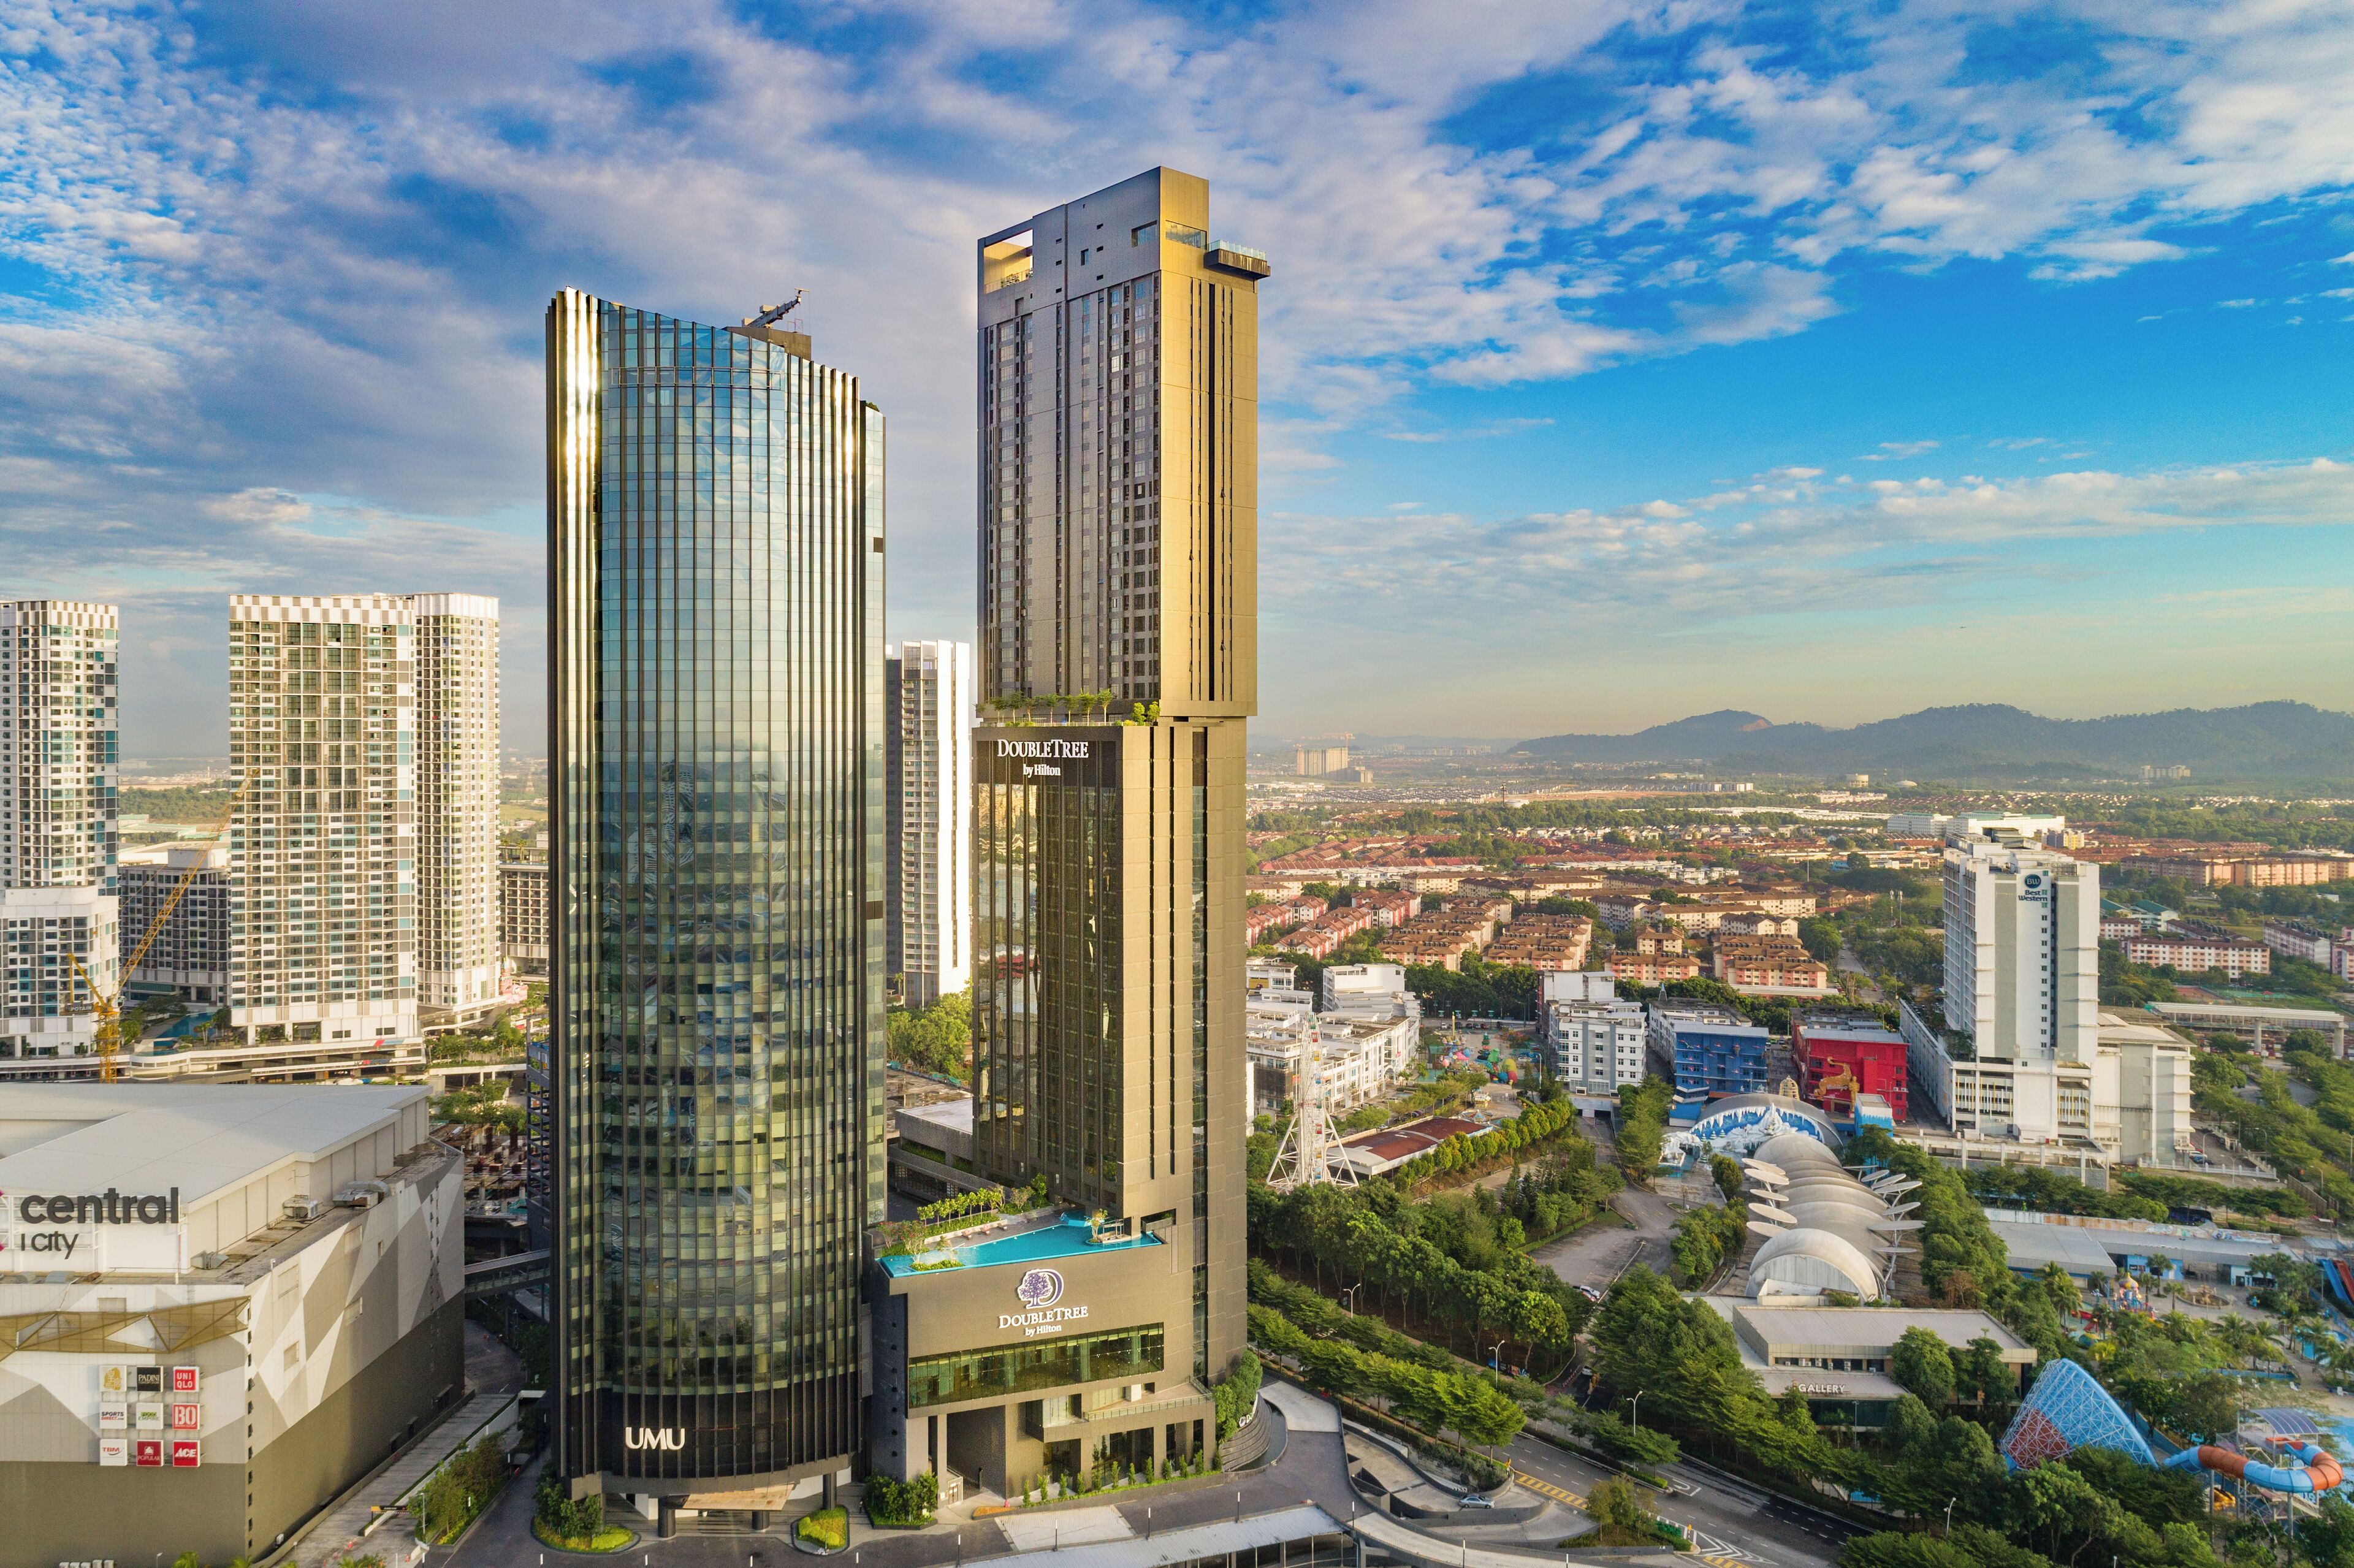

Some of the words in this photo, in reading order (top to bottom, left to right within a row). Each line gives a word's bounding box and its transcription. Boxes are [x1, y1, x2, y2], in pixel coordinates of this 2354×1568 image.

[1023, 764, 1034, 778] by
[1034, 764, 1061, 776] Hilton
[20, 1187, 178, 1224] central
[1025, 1327, 1036, 1337] by
[1036, 1324, 1062, 1334] Hilton
[625, 1427, 685, 1450] UMU
[175, 1448, 196, 1457] ACE
